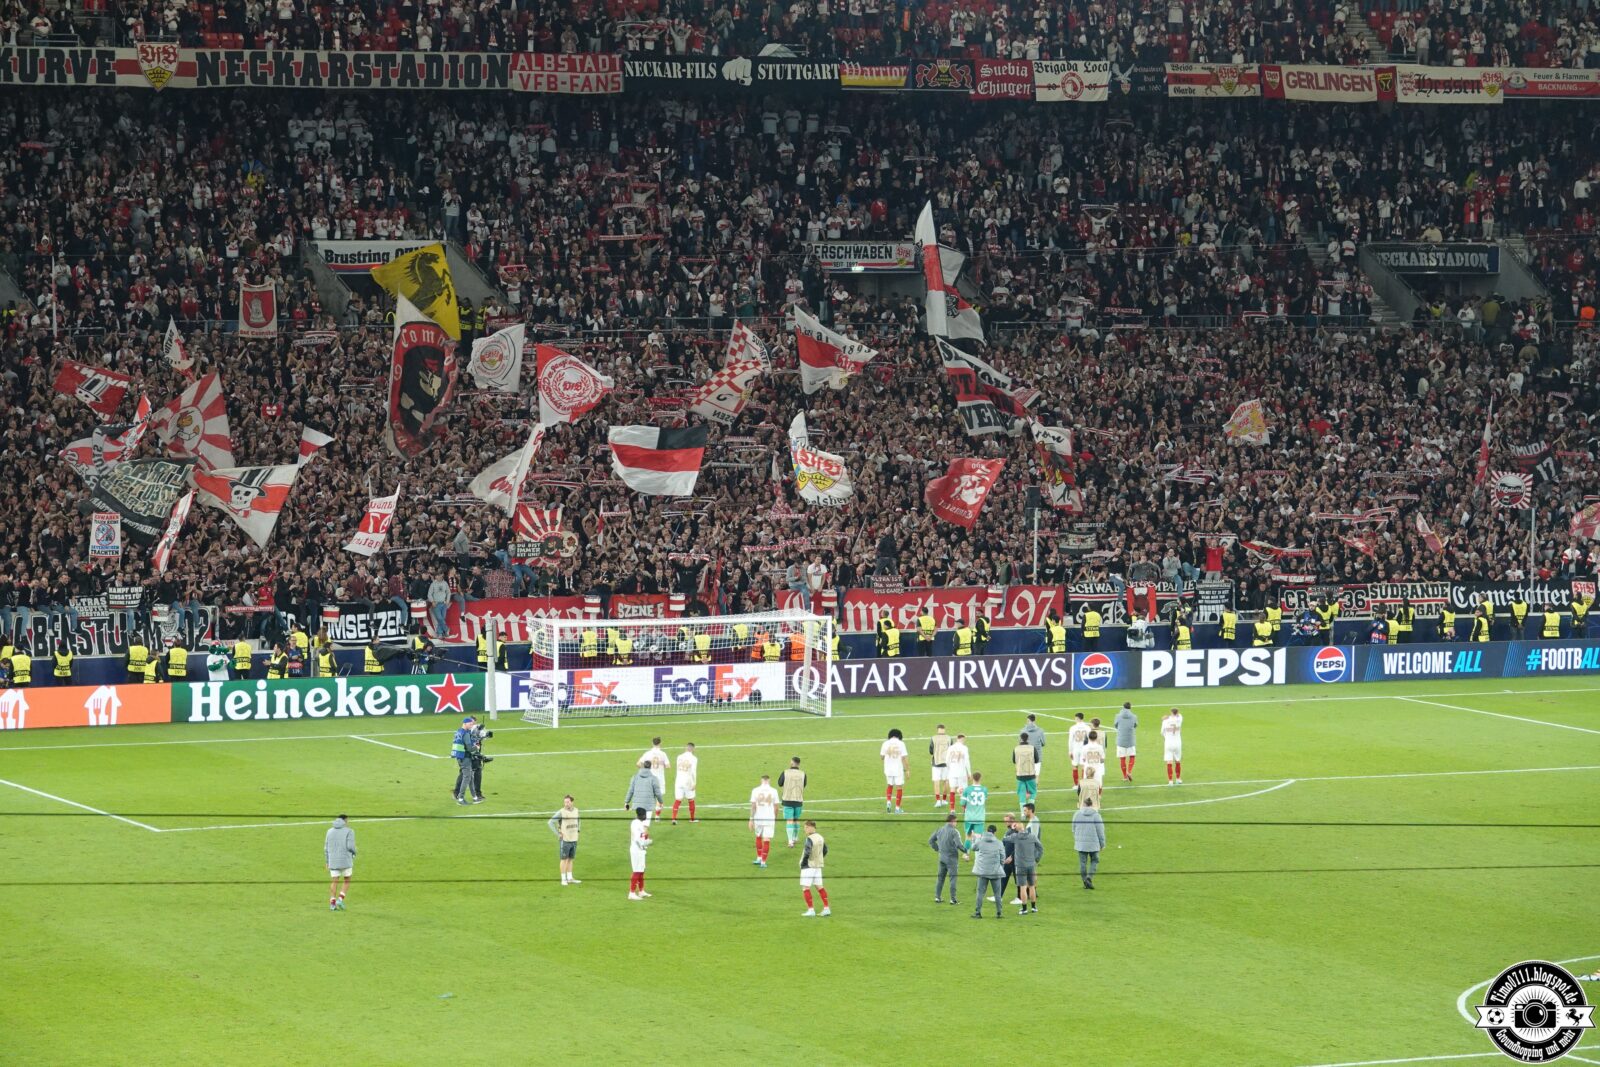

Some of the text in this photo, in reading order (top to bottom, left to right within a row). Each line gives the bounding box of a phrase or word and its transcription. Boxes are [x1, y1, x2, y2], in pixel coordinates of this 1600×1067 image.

[196, 49, 511, 89] NECKARSTADION
[516, 52, 622, 73] ALBSTADT
[624, 60, 717, 79] NECKAR-FILS
[757, 62, 840, 81] STUTTGART
[980, 62, 1029, 78] Suebia
[1034, 61, 1109, 74] Brigada Loca
[518, 72, 622, 93] VFB-FANS
[1285, 71, 1373, 92] GERLINGEN
[1414, 73, 1481, 97] Hessen
[1533, 72, 1590, 81] Feuer & Flamme
[324, 249, 390, 264] Brustring
[1343, 590, 1367, 609] 36
[1370, 581, 1449, 601] SÜDBANDE
[617, 602, 653, 618] SZENE
[1011, 588, 1057, 627] 97
[1081, 666, 1111, 677] PEPSI
[1141, 647, 1287, 688] PEPSI
[1315, 660, 1345, 670] PEPSI
[1383, 649, 1482, 675] WELCOME ALL
[653, 665, 759, 704] FedEx
[792, 656, 1068, 699] QATAR AIRWAYS
[511, 669, 620, 709] FedEx
[188, 678, 425, 724] Heineken
[970, 791, 985, 805] 33
